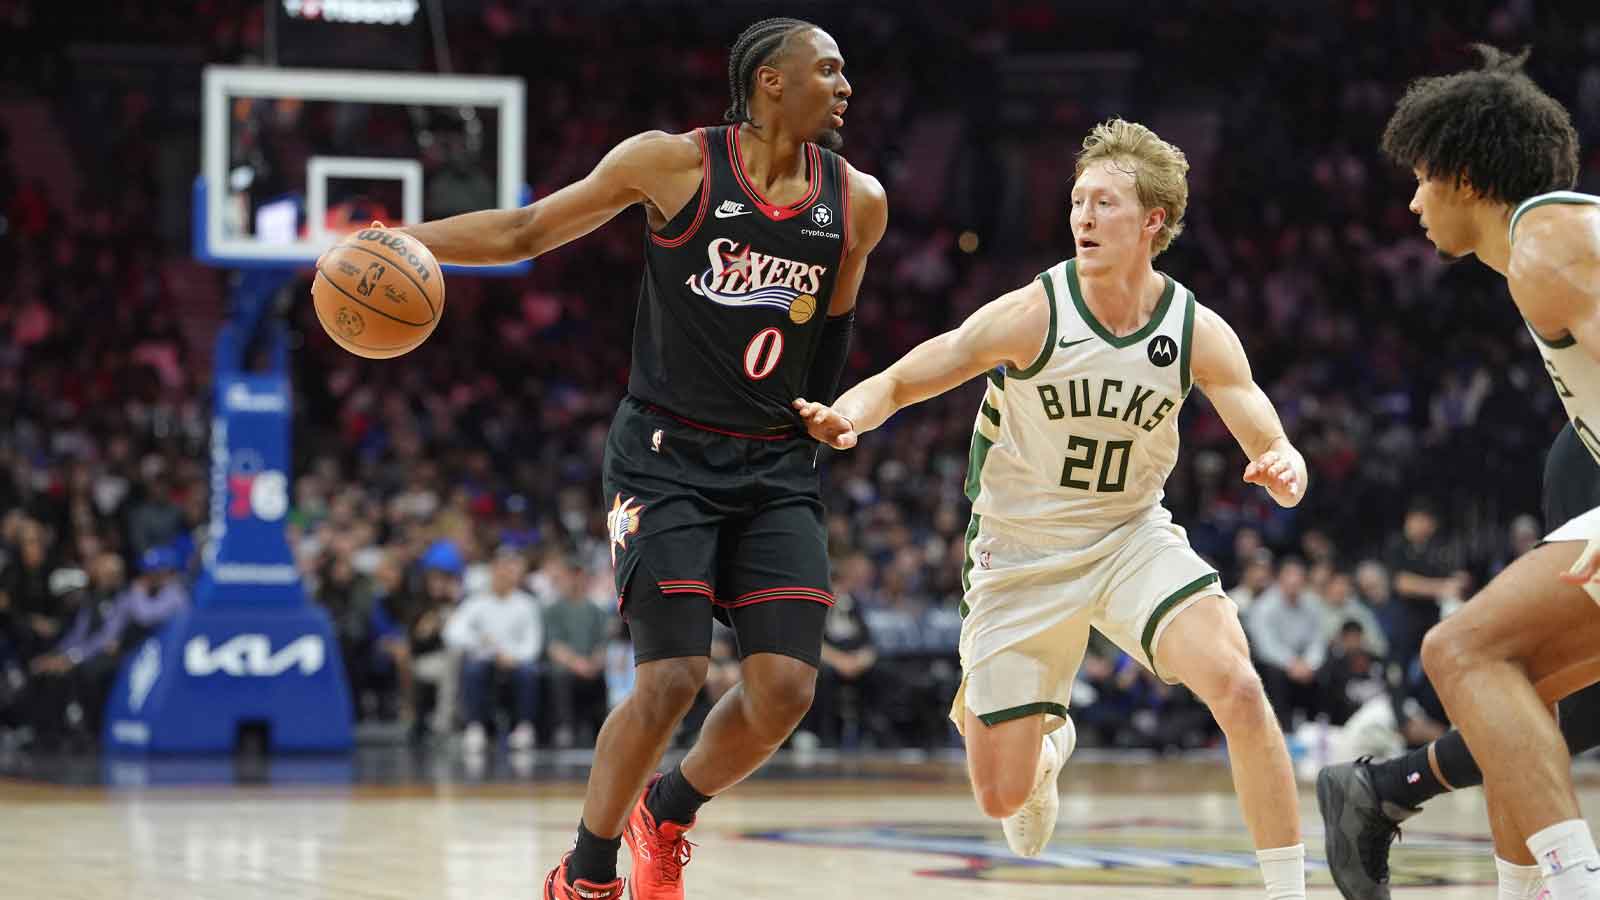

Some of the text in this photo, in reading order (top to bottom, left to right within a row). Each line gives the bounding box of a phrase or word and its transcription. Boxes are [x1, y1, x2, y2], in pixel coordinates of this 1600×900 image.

[721, 199, 745, 212] NIKE
[801, 228, 840, 240] crypto.com
[743, 327, 785, 381] 0
[1037, 379, 1175, 432] BUCKS
[1060, 435, 1133, 492] 20
